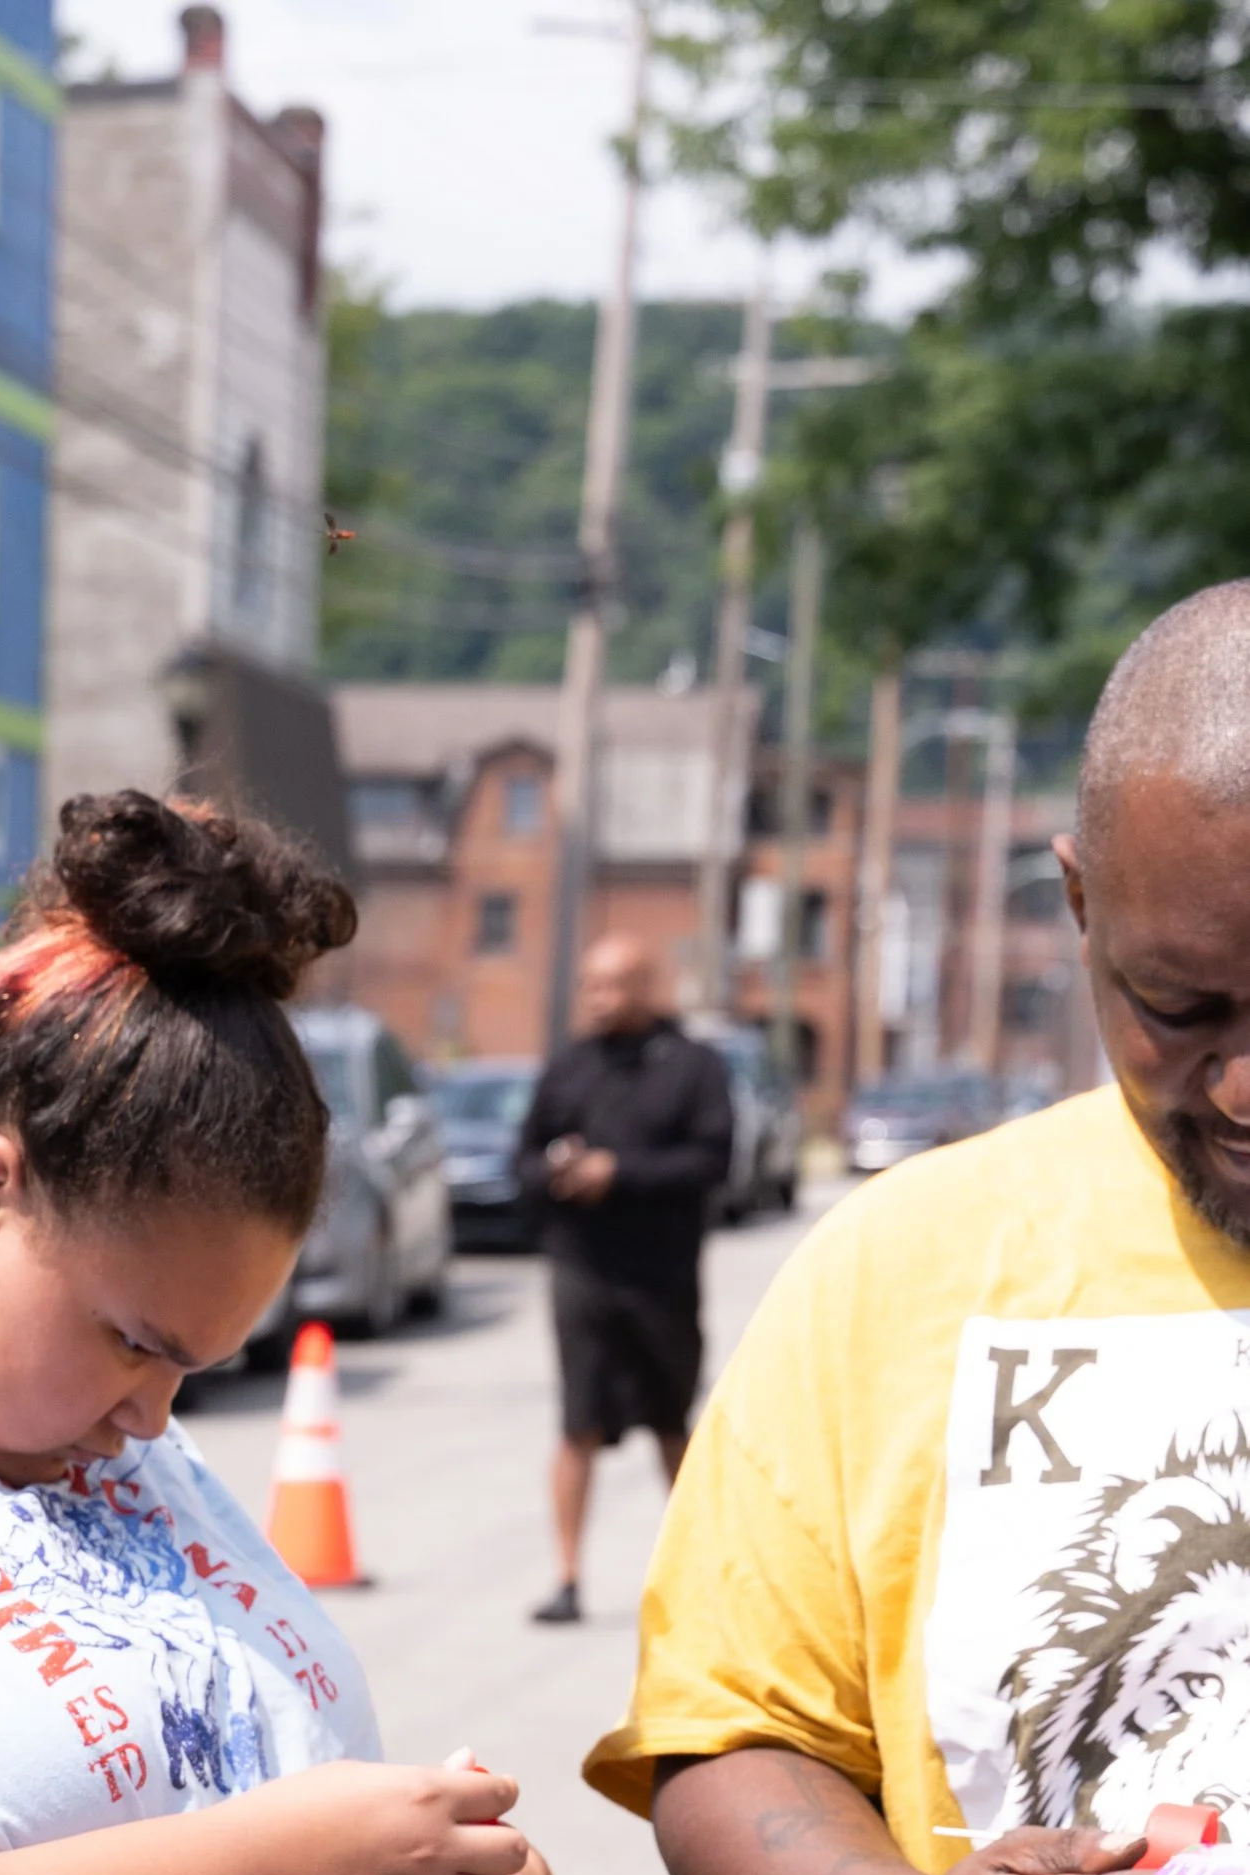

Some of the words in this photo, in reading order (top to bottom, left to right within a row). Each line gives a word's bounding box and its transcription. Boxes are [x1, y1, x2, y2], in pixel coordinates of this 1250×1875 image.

[980, 1345, 1098, 1487] K
[65, 1684, 129, 1746] ES
[294, 1661, 338, 1710] 76
